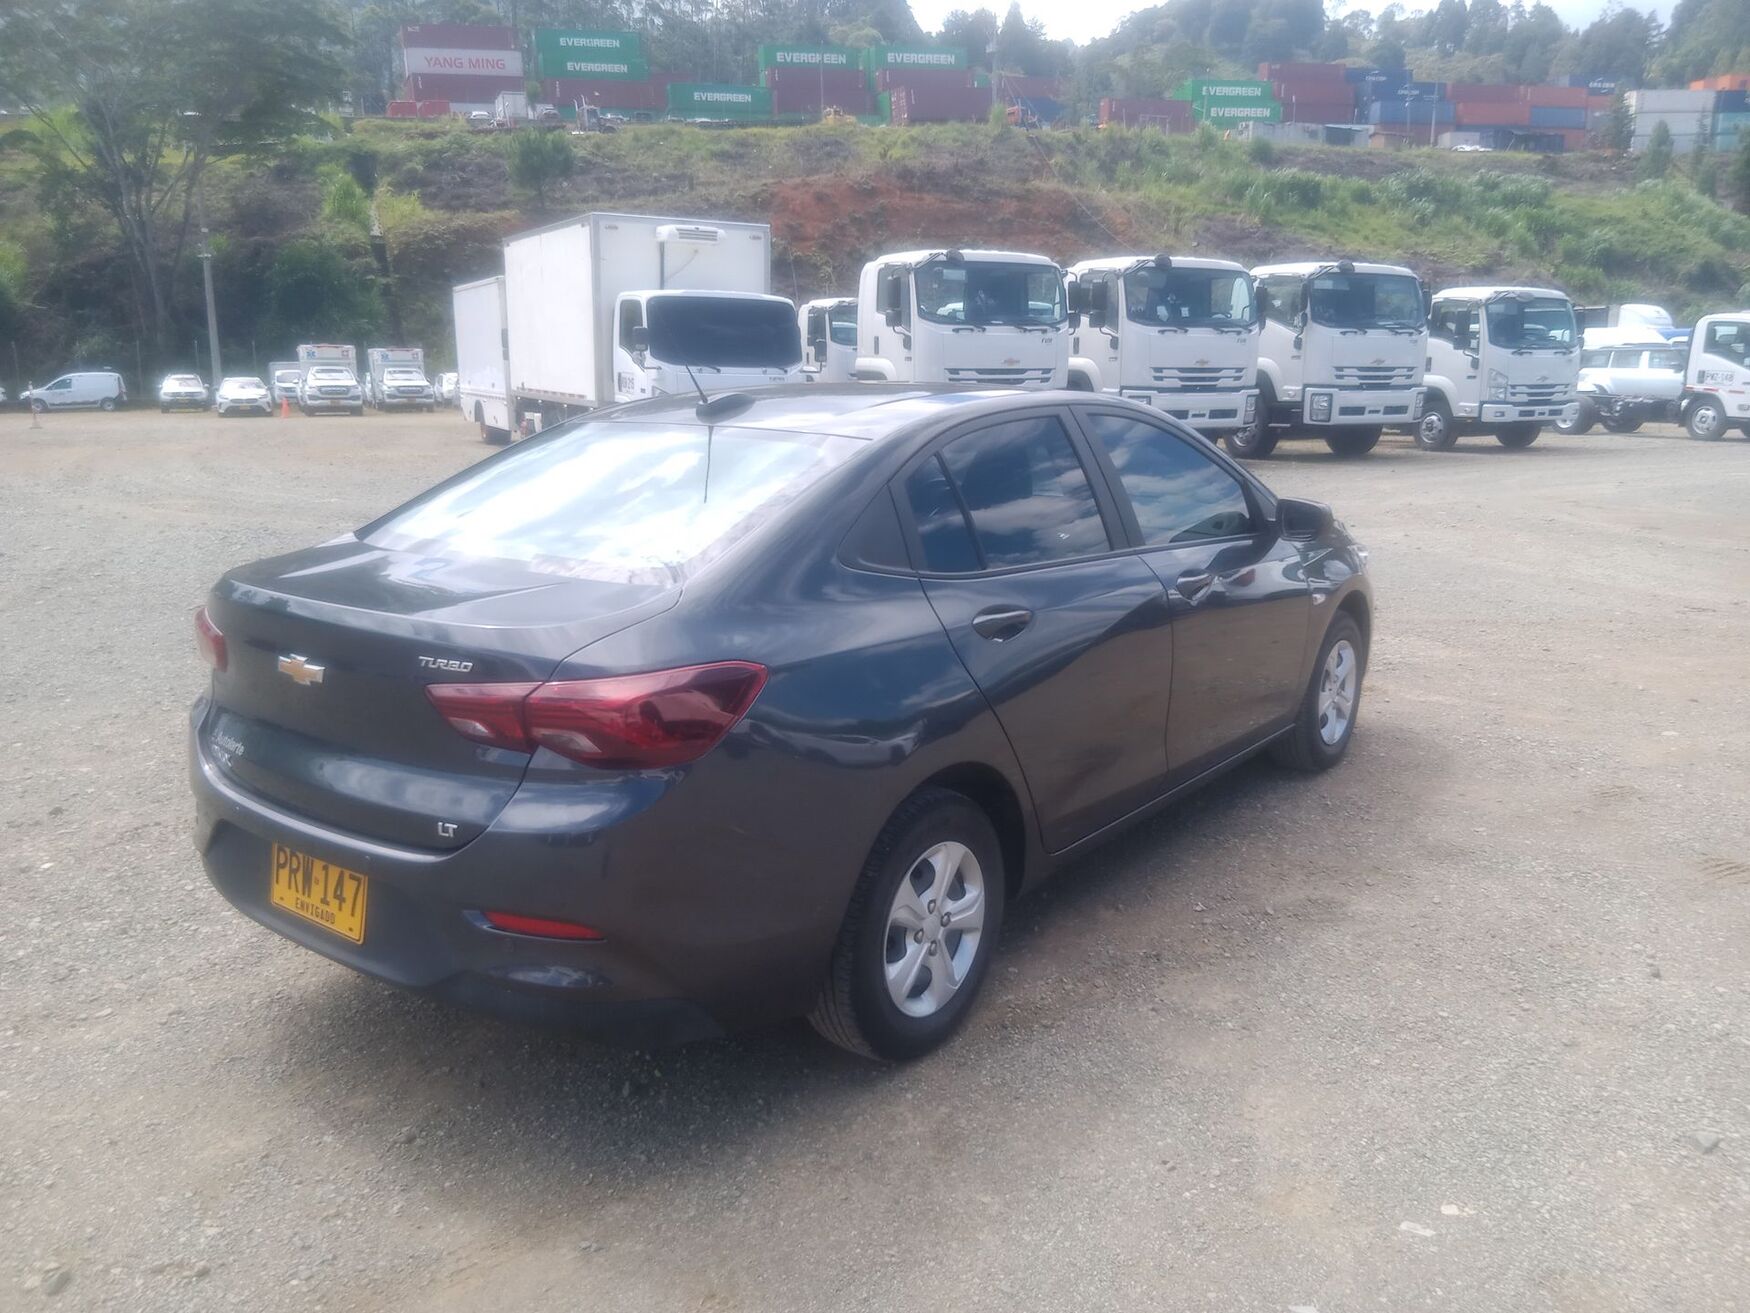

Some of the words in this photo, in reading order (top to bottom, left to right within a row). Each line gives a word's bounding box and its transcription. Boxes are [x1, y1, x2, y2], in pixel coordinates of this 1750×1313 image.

[560, 37, 620, 48] EVERGREEN
[424, 56, 464, 69] YANG
[468, 58, 506, 70] MING
[776, 52, 847, 64] EVERGREEN
[888, 52, 955, 64] EVERGREEN
[566, 62, 628, 73] EVERGREEN
[1202, 86, 1262, 96] EVERGREEN
[694, 92, 752, 103] EVERGREEN
[1210, 107, 1271, 117] EVERGREEN
[418, 655, 474, 673] TURBO
[438, 821, 458, 838] LT
[275, 846, 314, 899] PRW
[320, 863, 363, 918] 147
[295, 896, 336, 925] ENVIGADO
